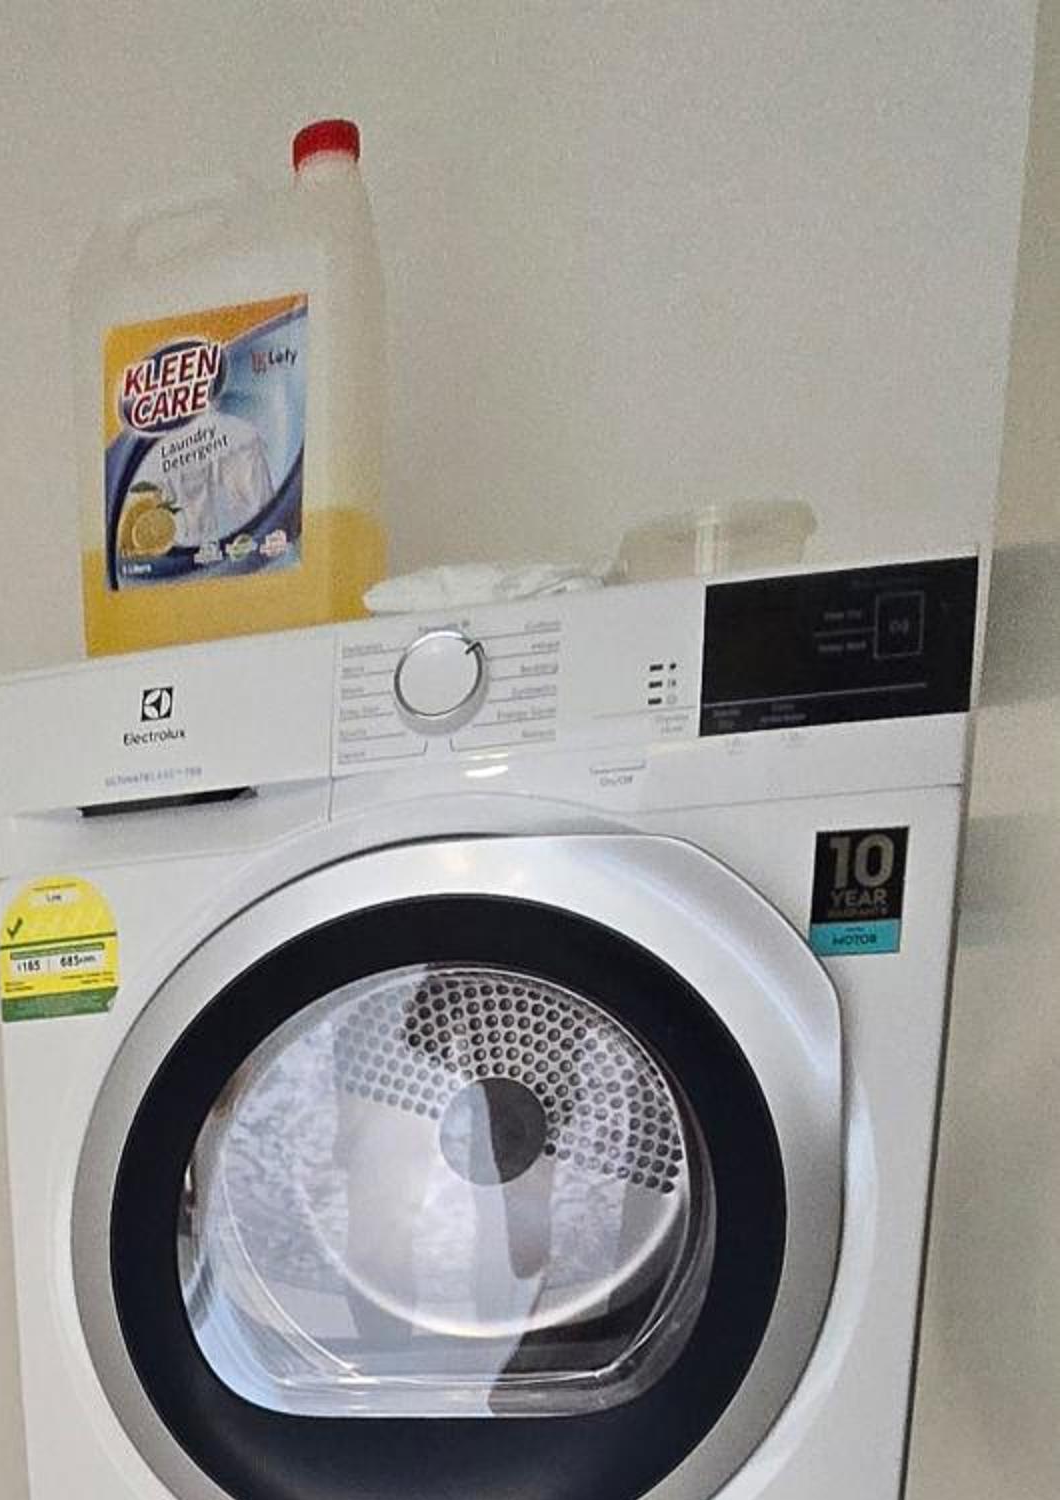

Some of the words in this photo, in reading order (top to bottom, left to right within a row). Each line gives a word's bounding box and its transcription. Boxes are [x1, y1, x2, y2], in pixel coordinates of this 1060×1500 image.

[123, 344, 220, 398] KLEEN
[132, 381, 209, 426] CARE
[161, 425, 217, 459] Laundry
[162, 435, 228, 473] Detergent
[122, 728, 186, 747] Electrolux
[828, 833, 895, 889] 10
[829, 888, 889, 910] YEAR
[831, 933, 878, 946] MOTOR
